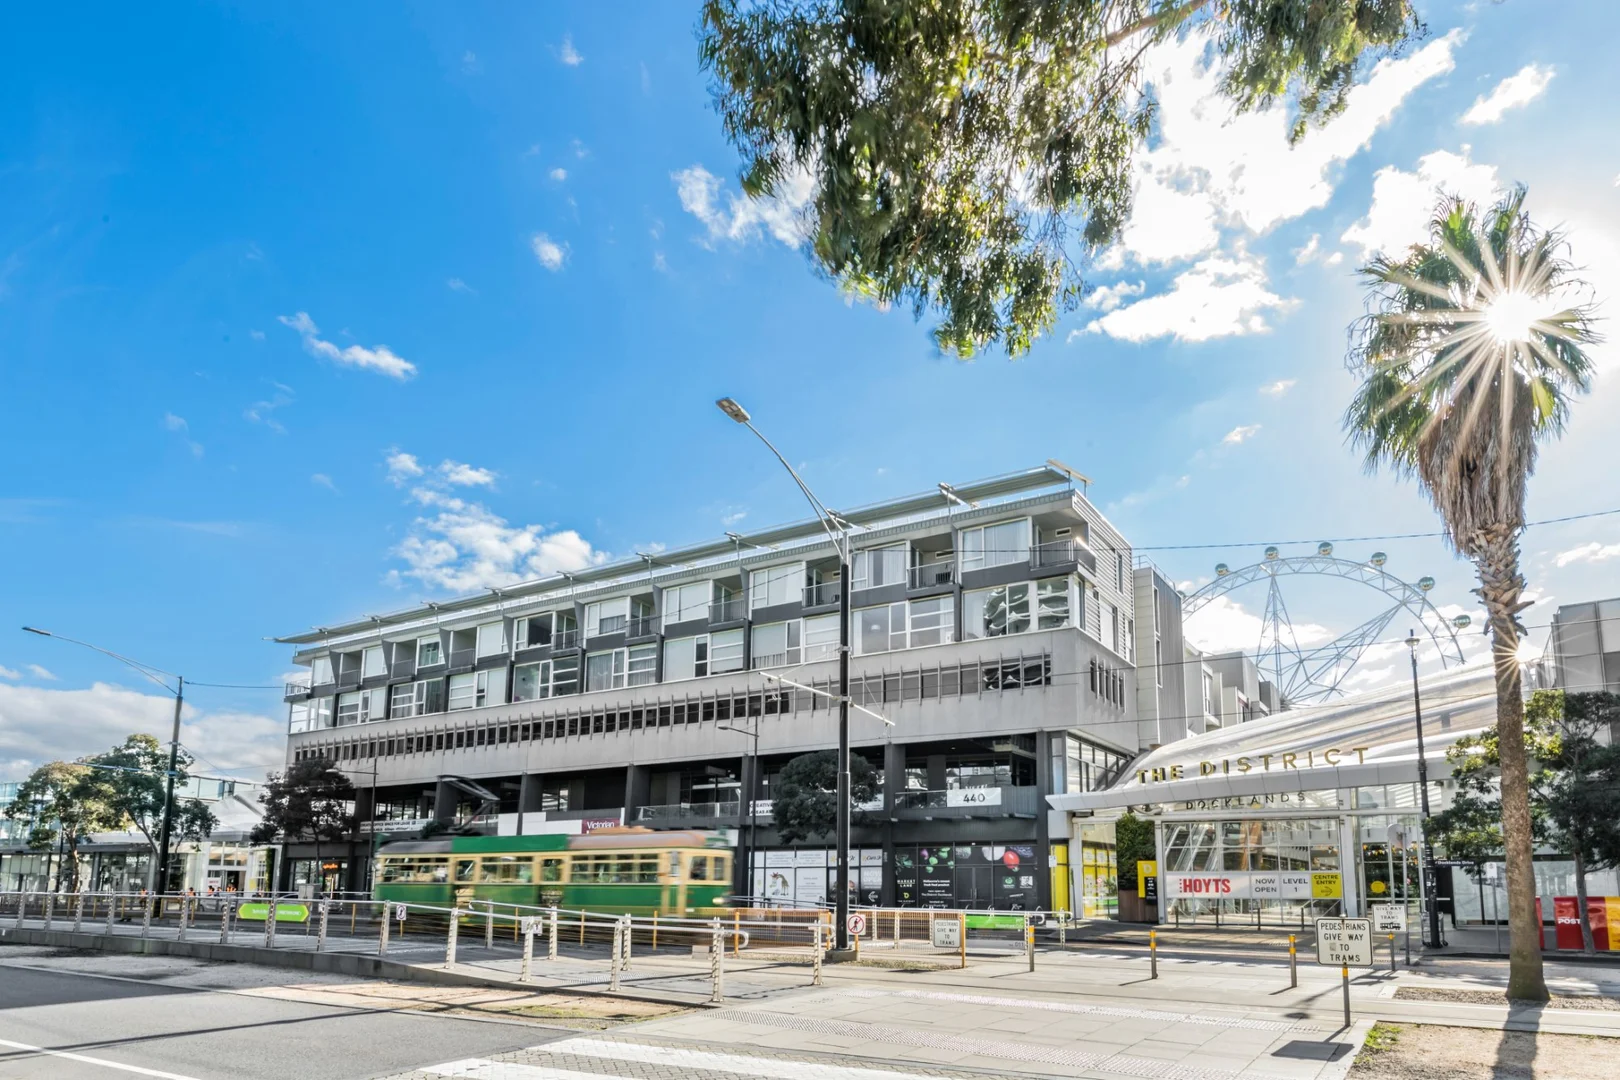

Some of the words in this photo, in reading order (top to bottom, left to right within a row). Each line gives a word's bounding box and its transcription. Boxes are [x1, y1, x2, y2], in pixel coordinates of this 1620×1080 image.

[1136, 764, 1184, 784] THE
[1200, 747, 1369, 776] DISTRICT
[1186, 791, 1306, 810] DOCKLANDS
[586, 821, 615, 830] Victorian
[1183, 878, 1231, 893] HOYTS
[1320, 922, 1366, 931] PEDESTRIANS
[1323, 933, 1342, 941] GIVE
[1347, 933, 1364, 941] WAY
[1339, 943, 1350, 951] TO
[1329, 953, 1360, 962] TRAMS
